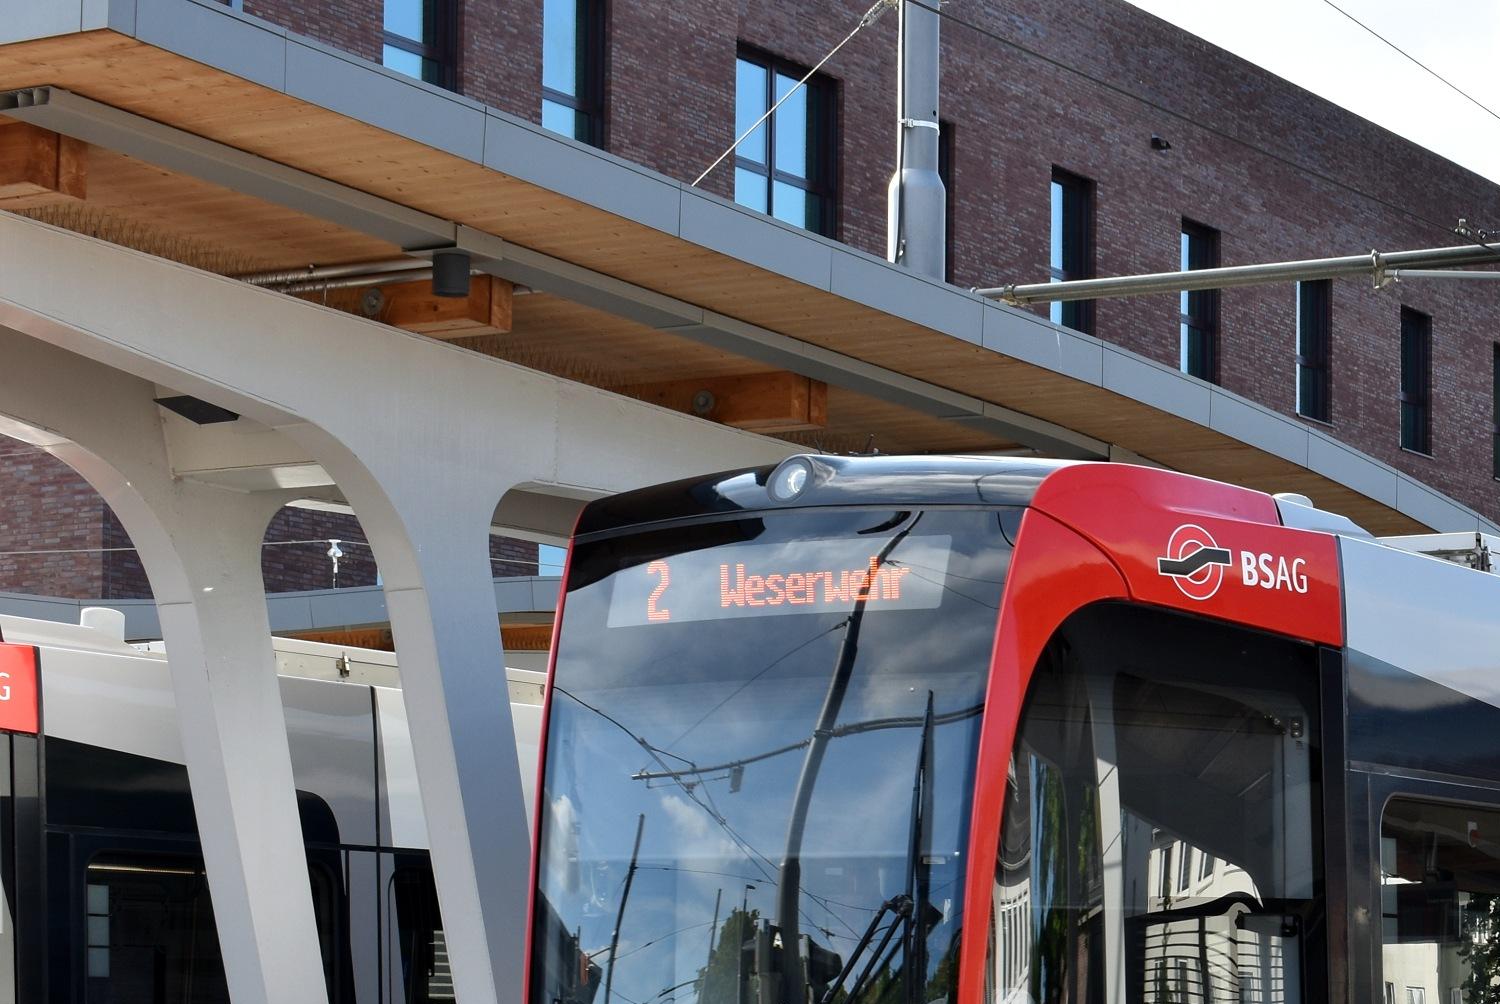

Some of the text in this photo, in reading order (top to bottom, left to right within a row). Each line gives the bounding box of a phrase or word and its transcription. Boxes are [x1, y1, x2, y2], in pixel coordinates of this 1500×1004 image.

[647, 556, 910, 620] 2 Weserwehr
[1241, 551, 1308, 593] BSAG
